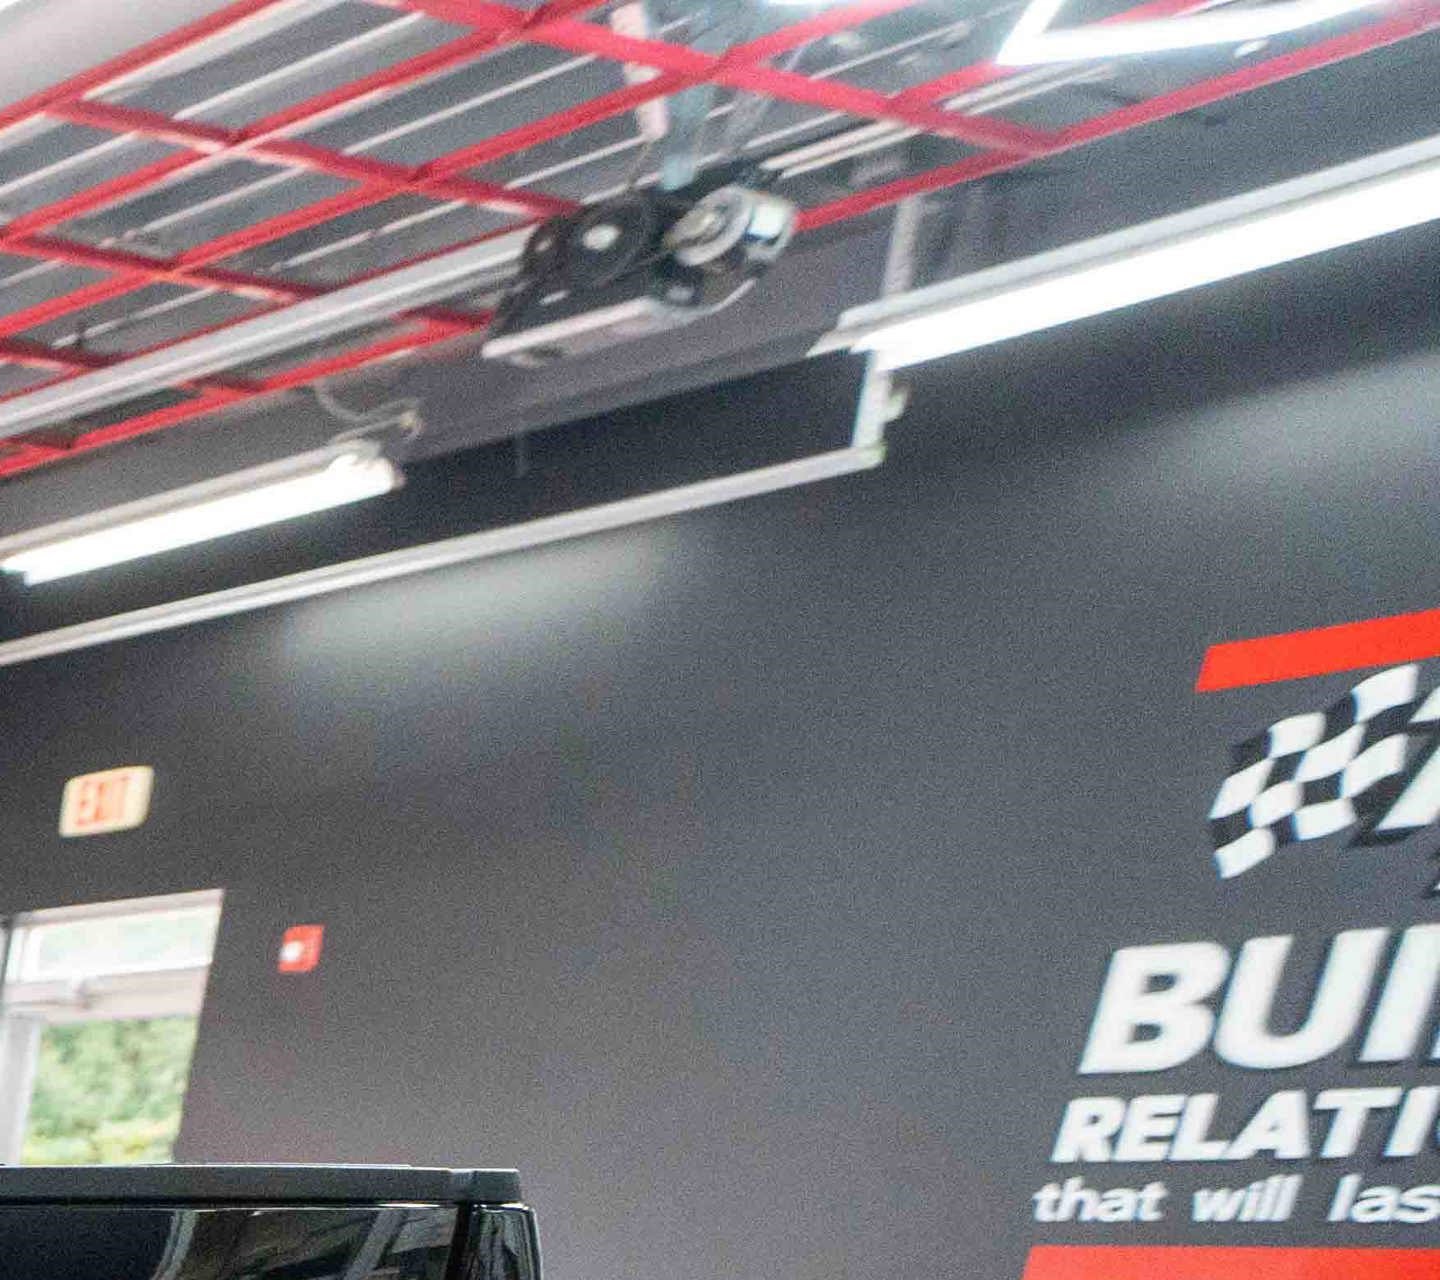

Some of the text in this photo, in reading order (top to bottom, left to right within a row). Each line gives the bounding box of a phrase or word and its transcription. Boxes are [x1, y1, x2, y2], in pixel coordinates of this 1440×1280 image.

[1079, 923, 1440, 1073] BUI
[1051, 1085, 1440, 1163] RELATI
[1031, 1175, 1169, 1223] that
[1191, 1174, 1304, 1223] will
